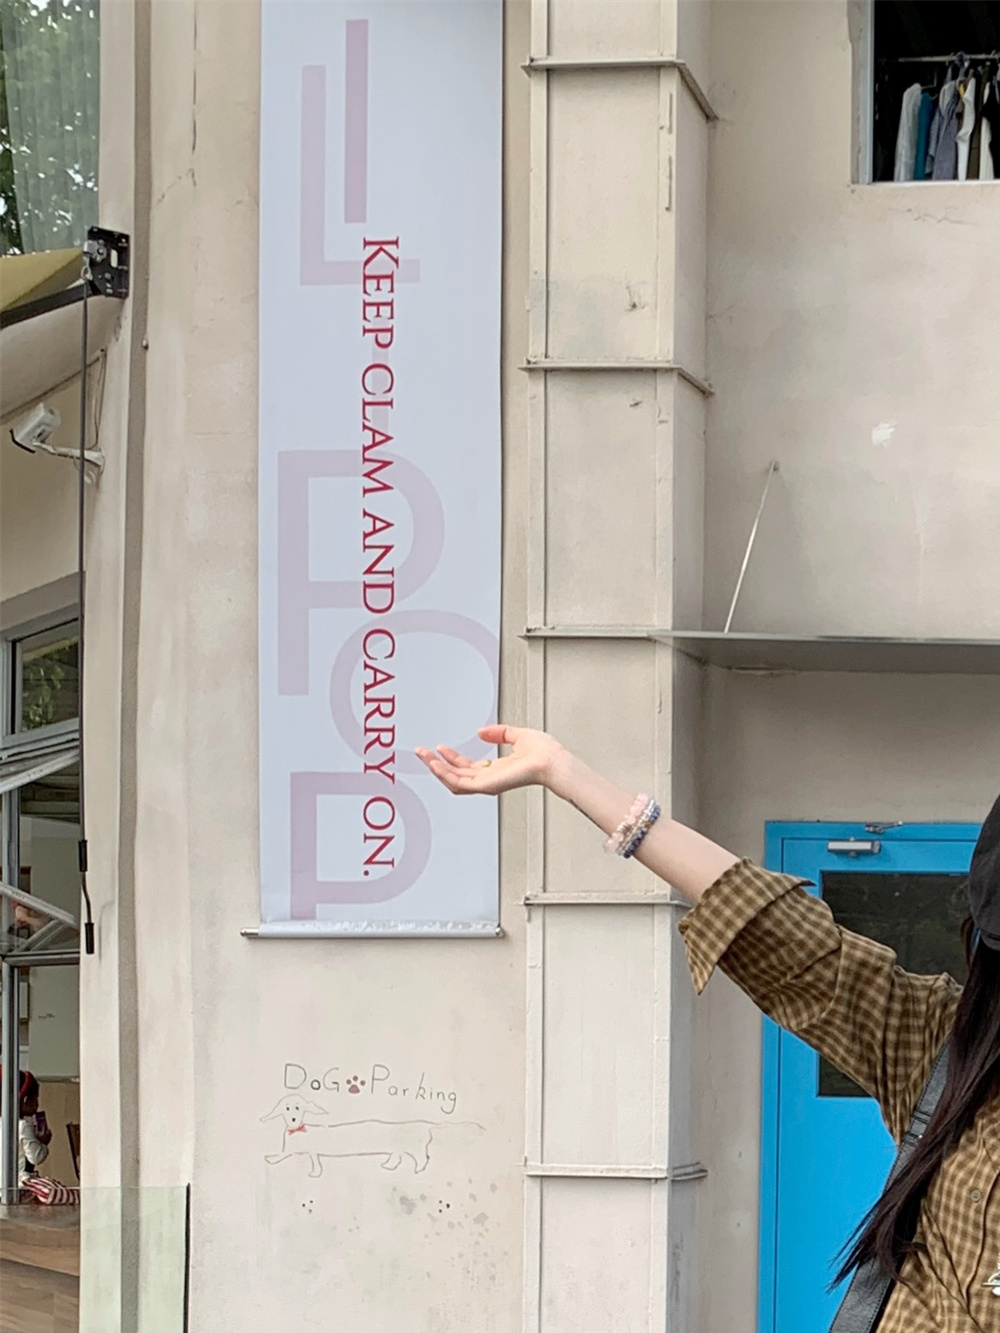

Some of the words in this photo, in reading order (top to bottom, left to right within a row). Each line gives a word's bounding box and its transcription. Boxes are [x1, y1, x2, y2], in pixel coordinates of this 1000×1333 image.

[362, 237, 400, 350] KEEP
[361, 362, 395, 497] CLAM
[362, 509, 396, 615] AND
[362, 627, 396, 784] CARRY
[362, 795, 396, 876] ON.
[284, 1063, 340, 1093] DoG
[371, 1063, 458, 1115] Parking
